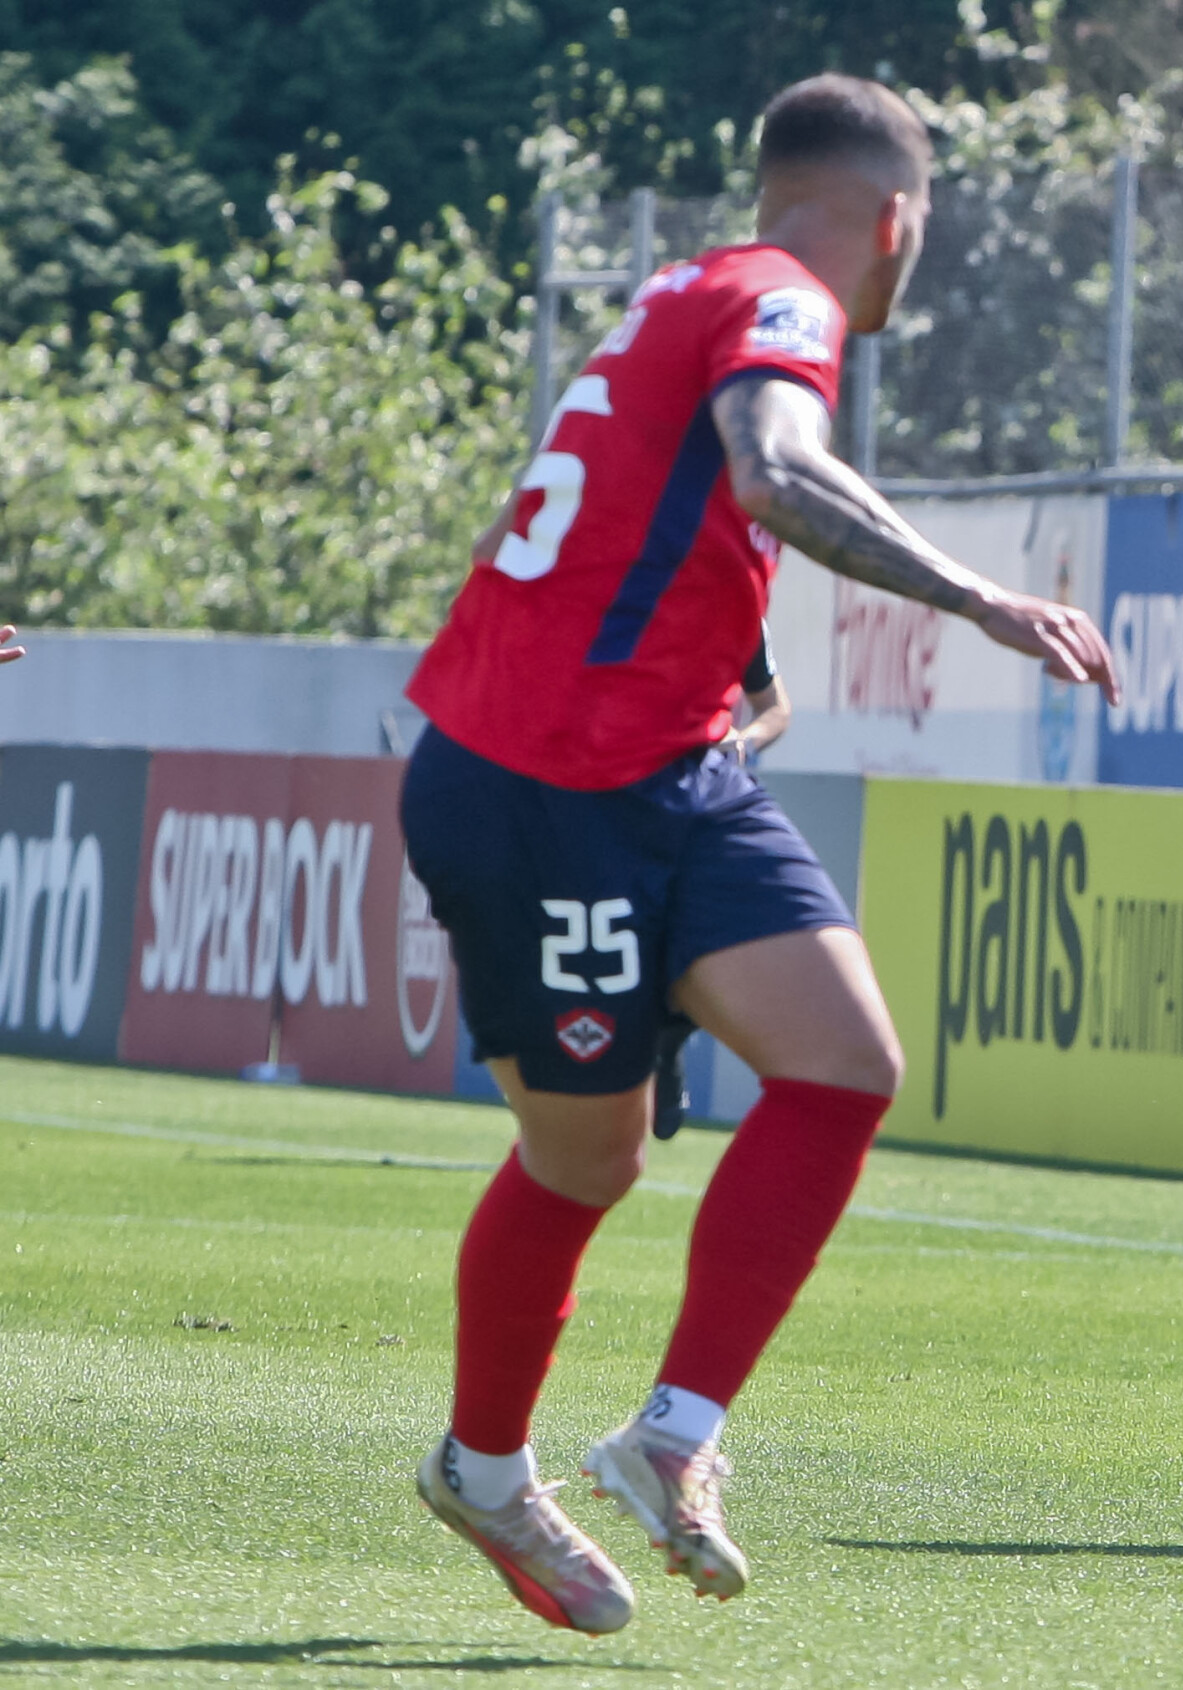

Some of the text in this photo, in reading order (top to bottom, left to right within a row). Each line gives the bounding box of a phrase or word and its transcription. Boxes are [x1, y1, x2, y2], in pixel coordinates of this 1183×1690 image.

[140, 808, 258, 995] SUPER
[251, 817, 373, 1008] BOCK
[541, 898, 640, 994] 25
[934, 811, 1088, 1123] pans
